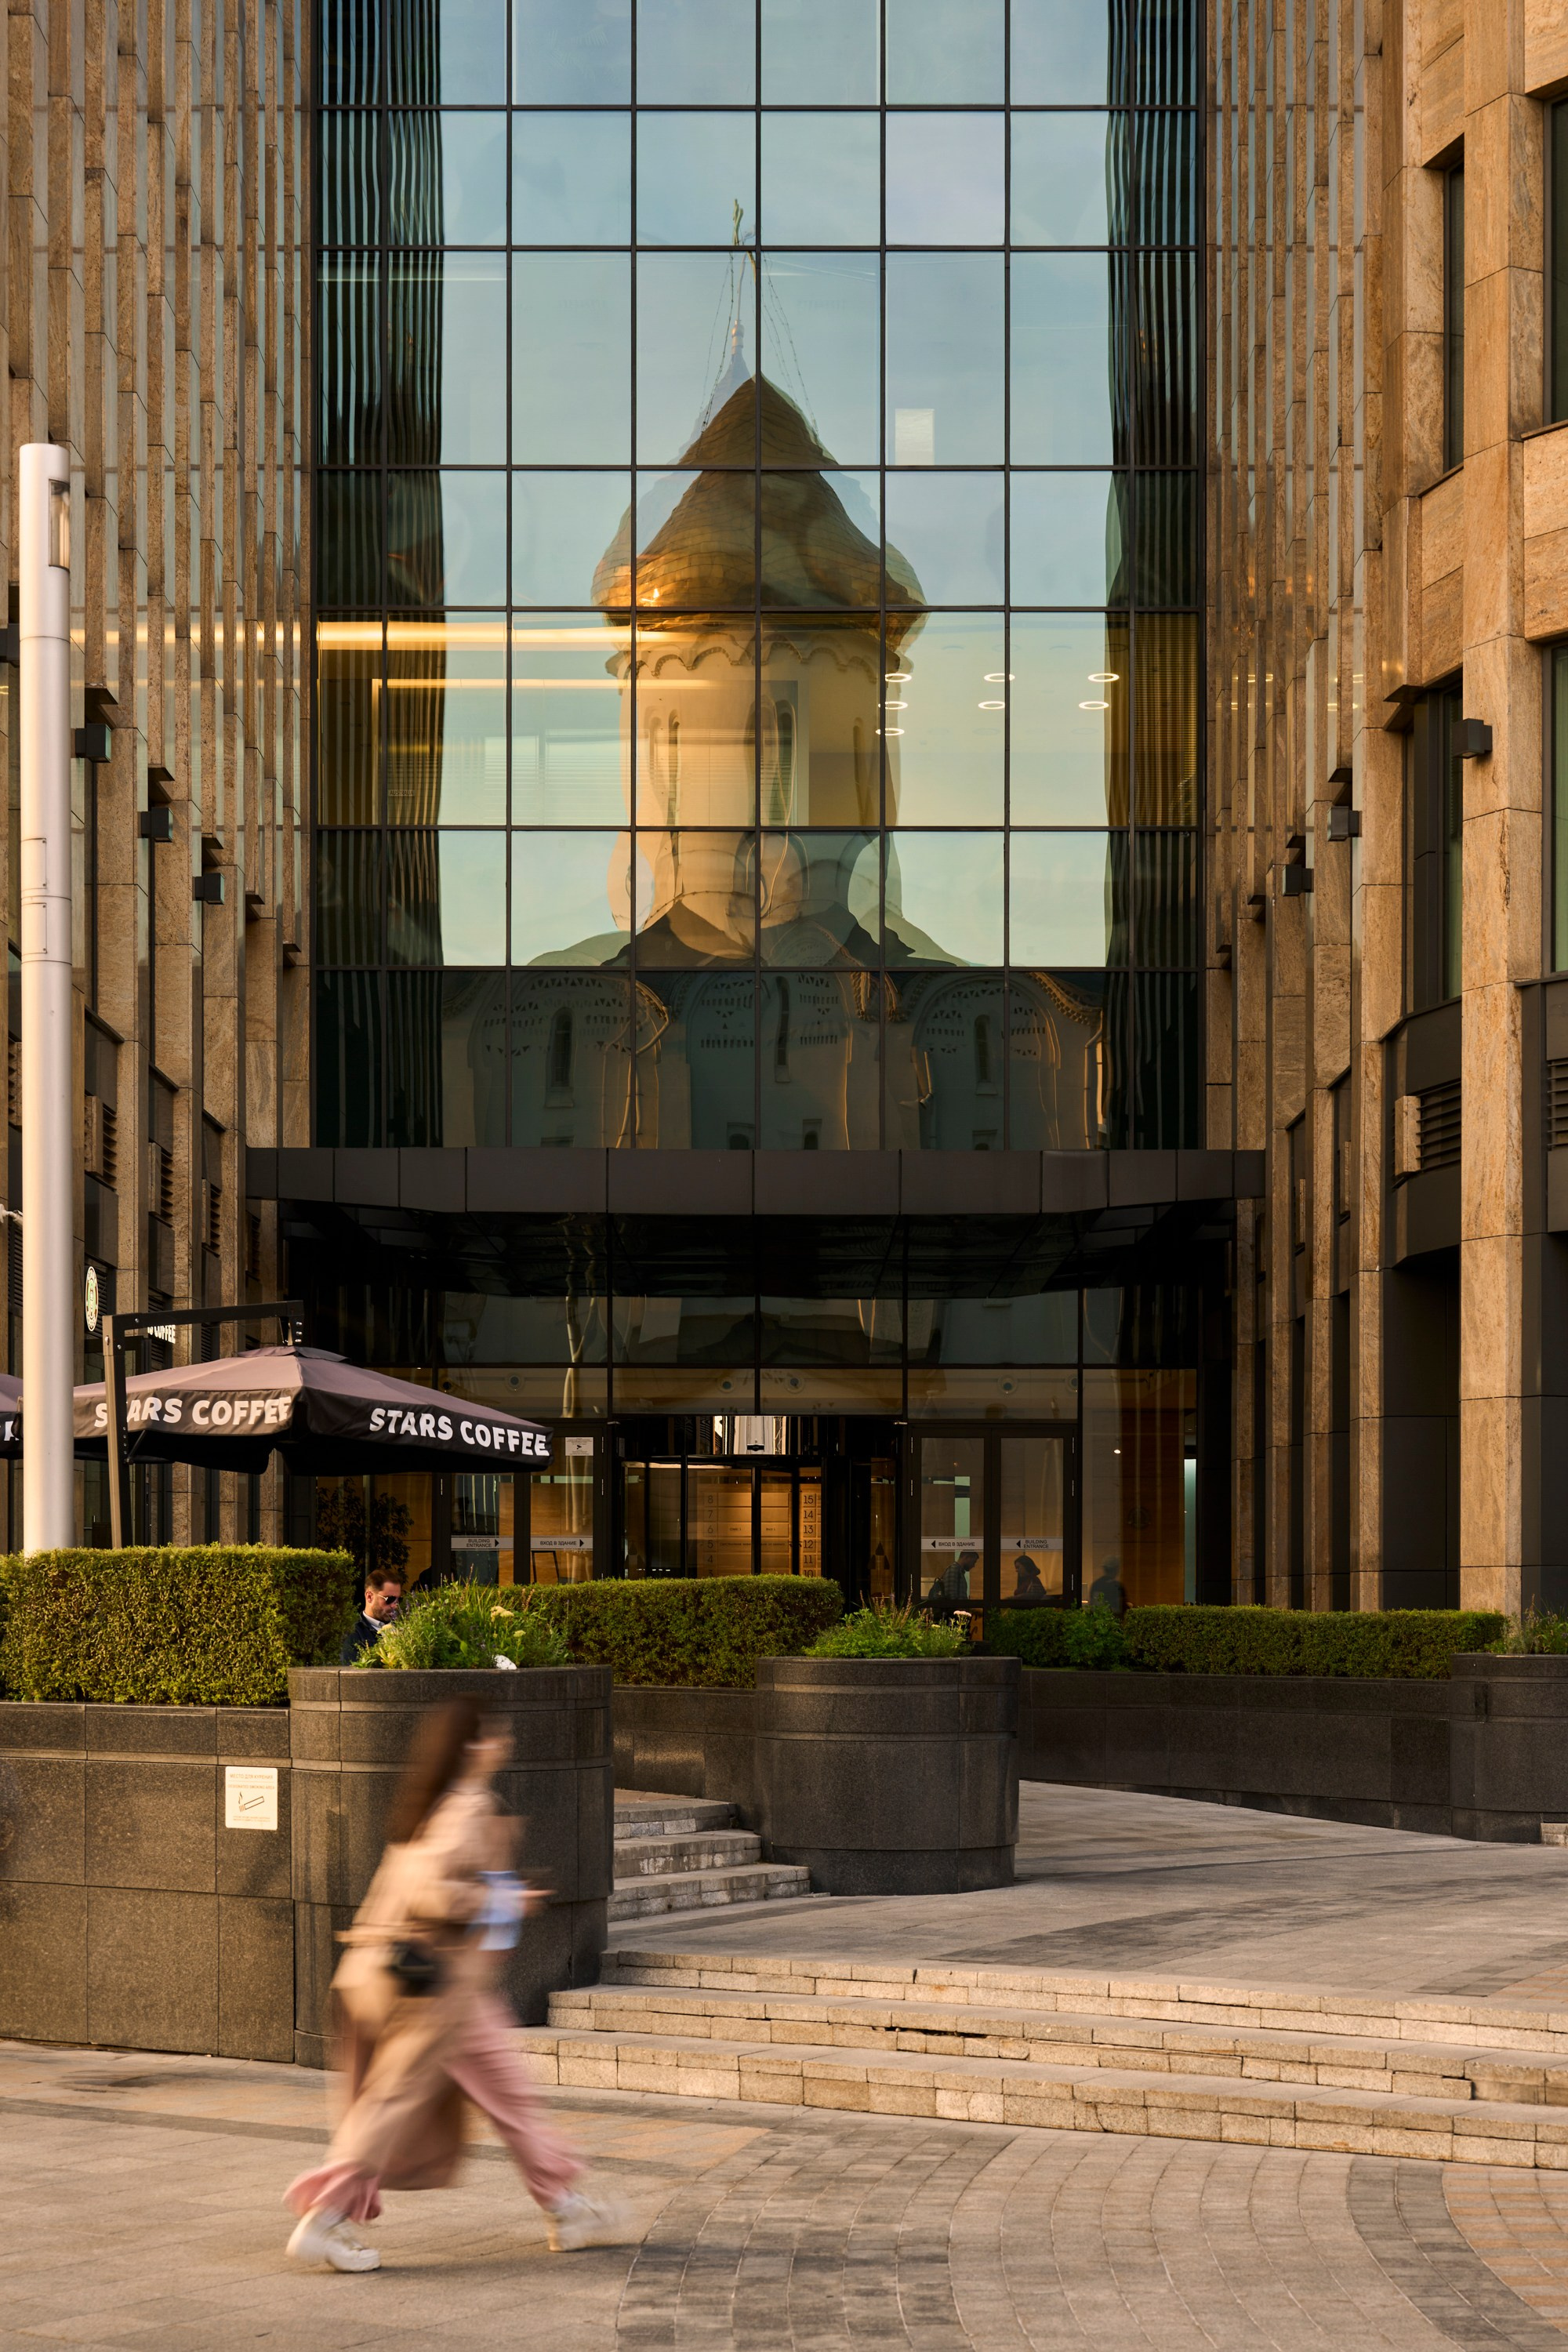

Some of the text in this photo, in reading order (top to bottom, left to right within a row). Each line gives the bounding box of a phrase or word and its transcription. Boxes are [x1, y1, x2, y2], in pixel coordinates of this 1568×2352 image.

[94, 1396, 292, 1428] SARS COFFEE
[369, 1407, 550, 1456] STARS COFFEE
[708, 1495, 713, 1503] 8
[803, 1495, 814, 1504] 15
[708, 1510, 713, 1518] 7
[803, 1510, 814, 1519] 14
[708, 1525, 713, 1534] 6
[803, 1525, 814, 1534] 13
[708, 1540, 713, 1549] 5
[803, 1540, 814, 1549] 12
[708, 1555, 713, 1564] 4
[804, 1555, 814, 1564] 11
[804, 1569, 814, 1577] 10
